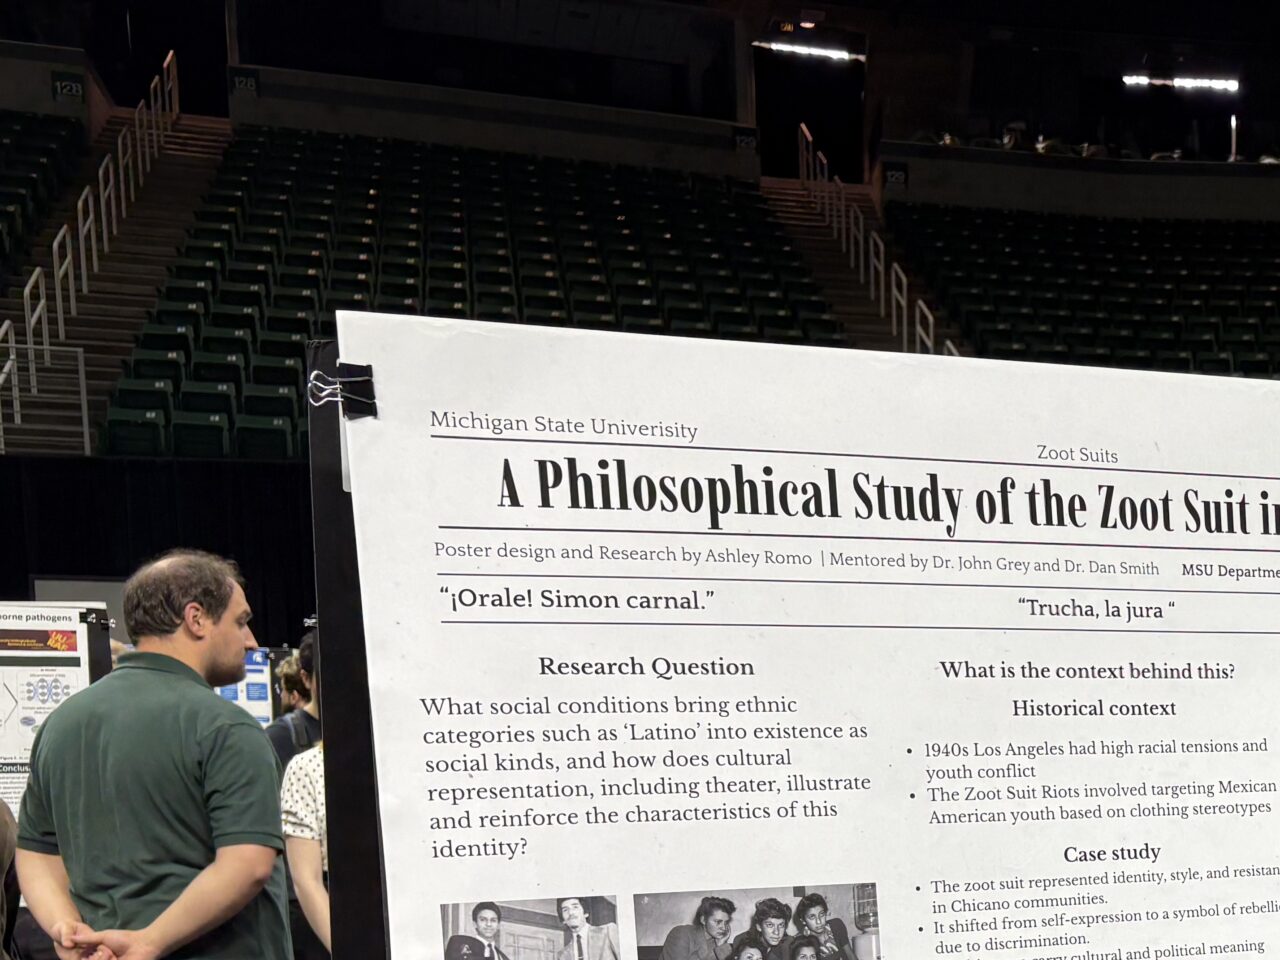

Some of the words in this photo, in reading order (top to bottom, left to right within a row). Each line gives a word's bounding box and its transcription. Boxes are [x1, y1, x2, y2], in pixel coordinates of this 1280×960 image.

[430, 410, 528, 435] Michigan
[534, 416, 584, 433] State
[591, 418, 697, 443] Univerisity
[1036, 444, 1075, 460] Zoot
[1079, 447, 1118, 463] Suits
[497, 458, 524, 507] A
[533, 456, 842, 530] Philosophical
[852, 472, 963, 538] Study
[975, 476, 1015, 524] of
[1024, 478, 1086, 527] the
[1097, 484, 1174, 531] Zoot
[1183, 488, 1250, 534] Suit
[1181, 563, 1213, 576] MSU
[440, 586, 532, 612] “¡Orale!
[540, 589, 620, 608] Simon
[626, 590, 714, 609] carnal.”
[26, 614, 72, 623] pathogens
[1018, 597, 1099, 619] “Trucha,
[1104, 599, 1121, 617] la
[1126, 601, 1163, 623] jura
[538, 656, 645, 675] Research
[651, 656, 754, 680] Question
[938, 660, 995, 678] What
[1000, 660, 1015, 678] is
[1020, 661, 1050, 678] the
[1055, 665, 1124, 678] context
[1128, 662, 1192, 679] behind
[1197, 662, 1234, 679] this?
[1012, 698, 1104, 716] Historical
[1109, 702, 1176, 715] context
[1063, 846, 1106, 862] Case
[1112, 842, 1161, 863] study
